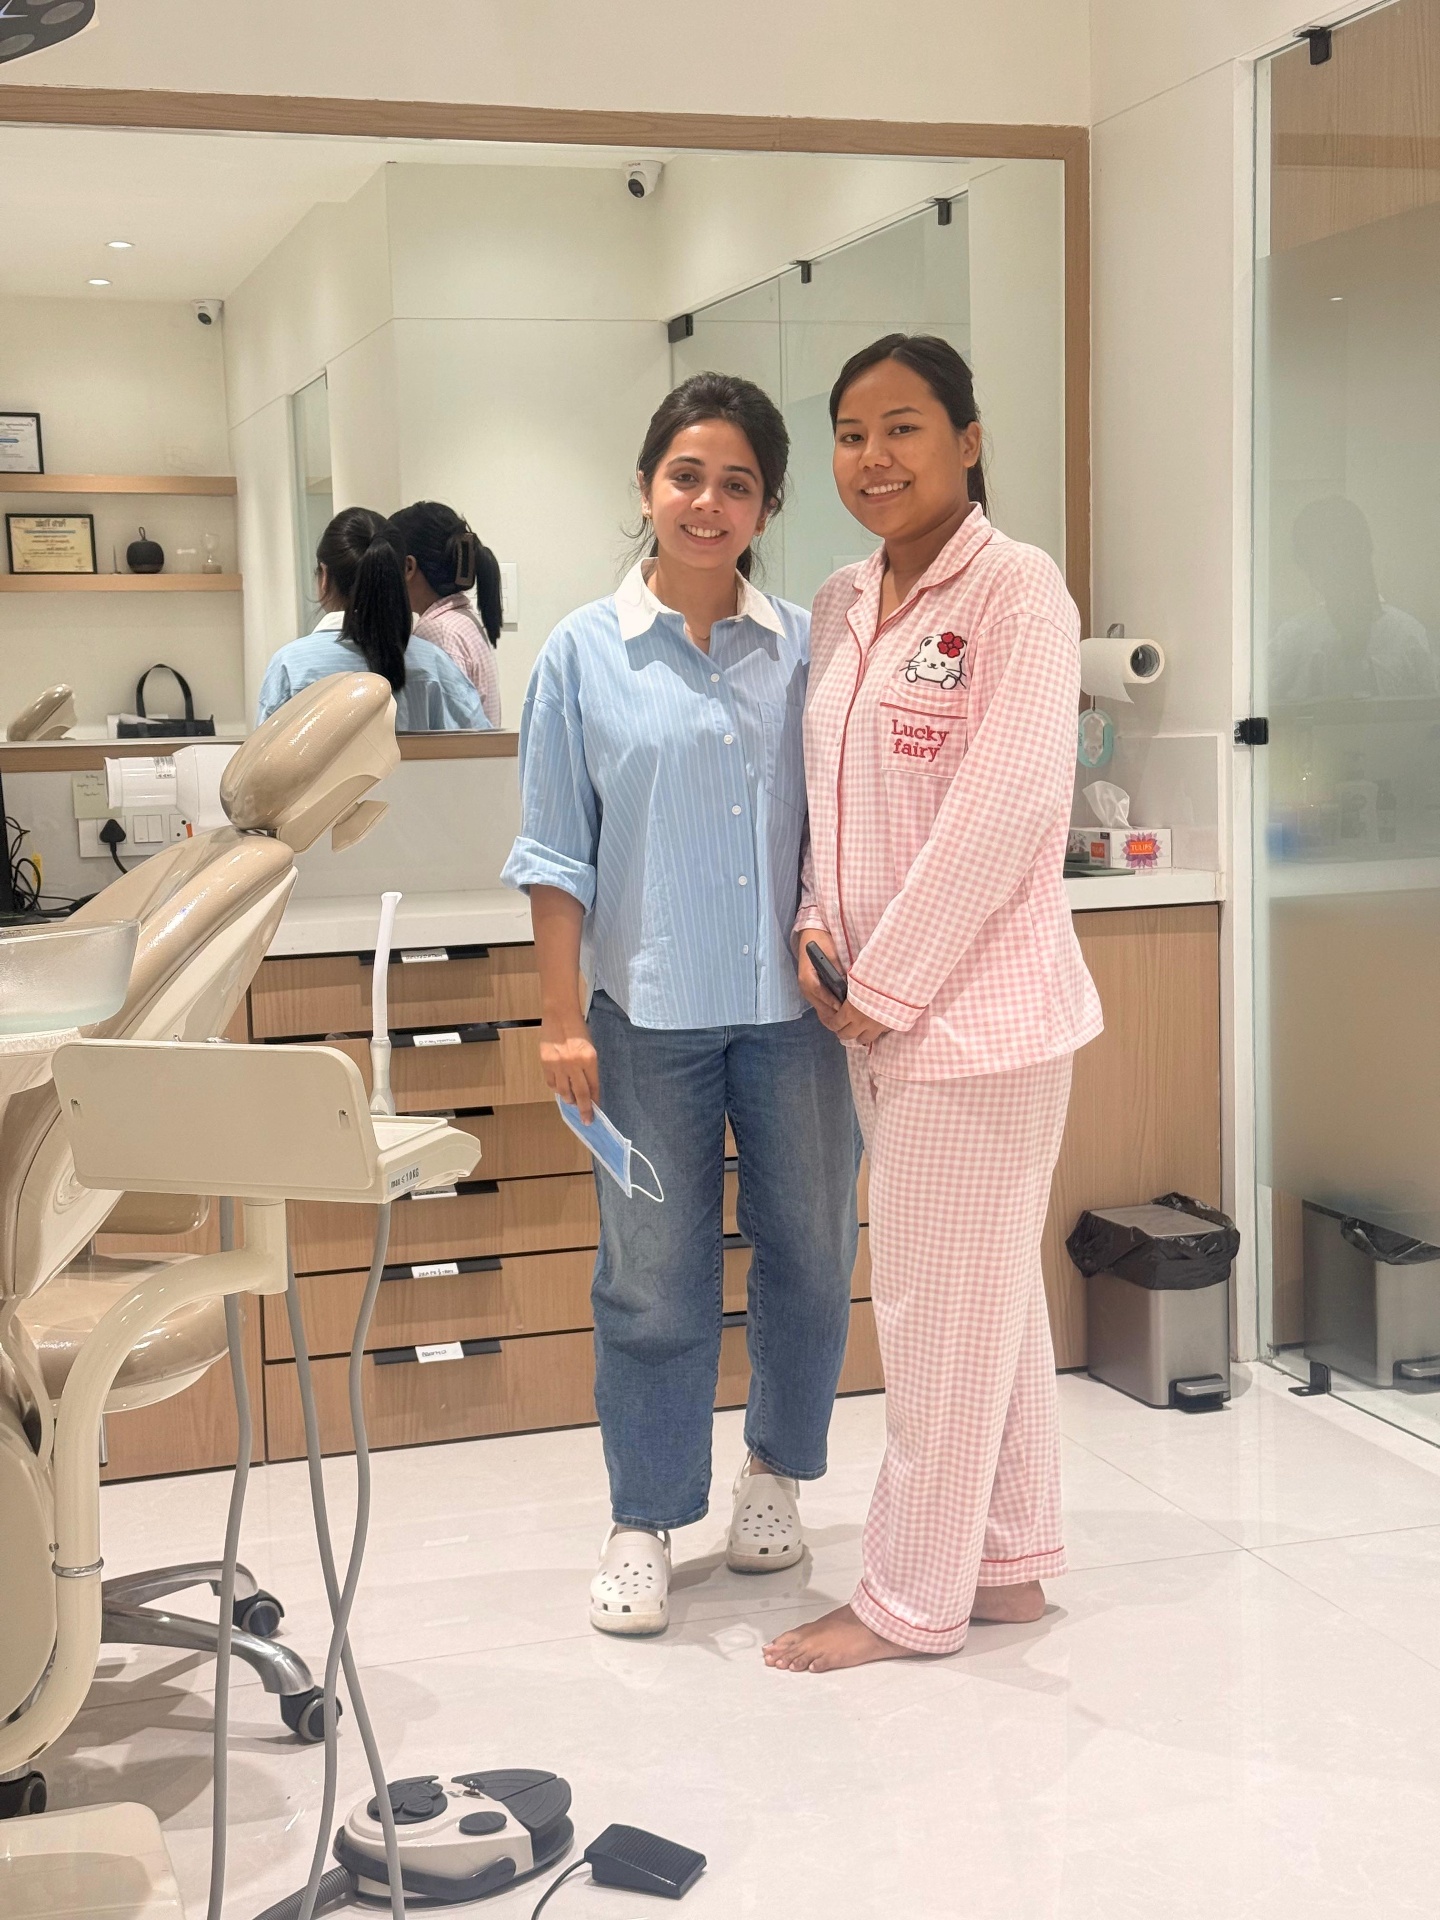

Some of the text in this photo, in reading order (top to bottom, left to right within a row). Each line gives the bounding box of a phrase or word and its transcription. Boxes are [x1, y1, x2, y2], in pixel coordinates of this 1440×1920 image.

[891, 719, 949, 747] Lucky
[893, 738, 941, 762] fairy
[1130, 843, 1153, 851] TULIPS
